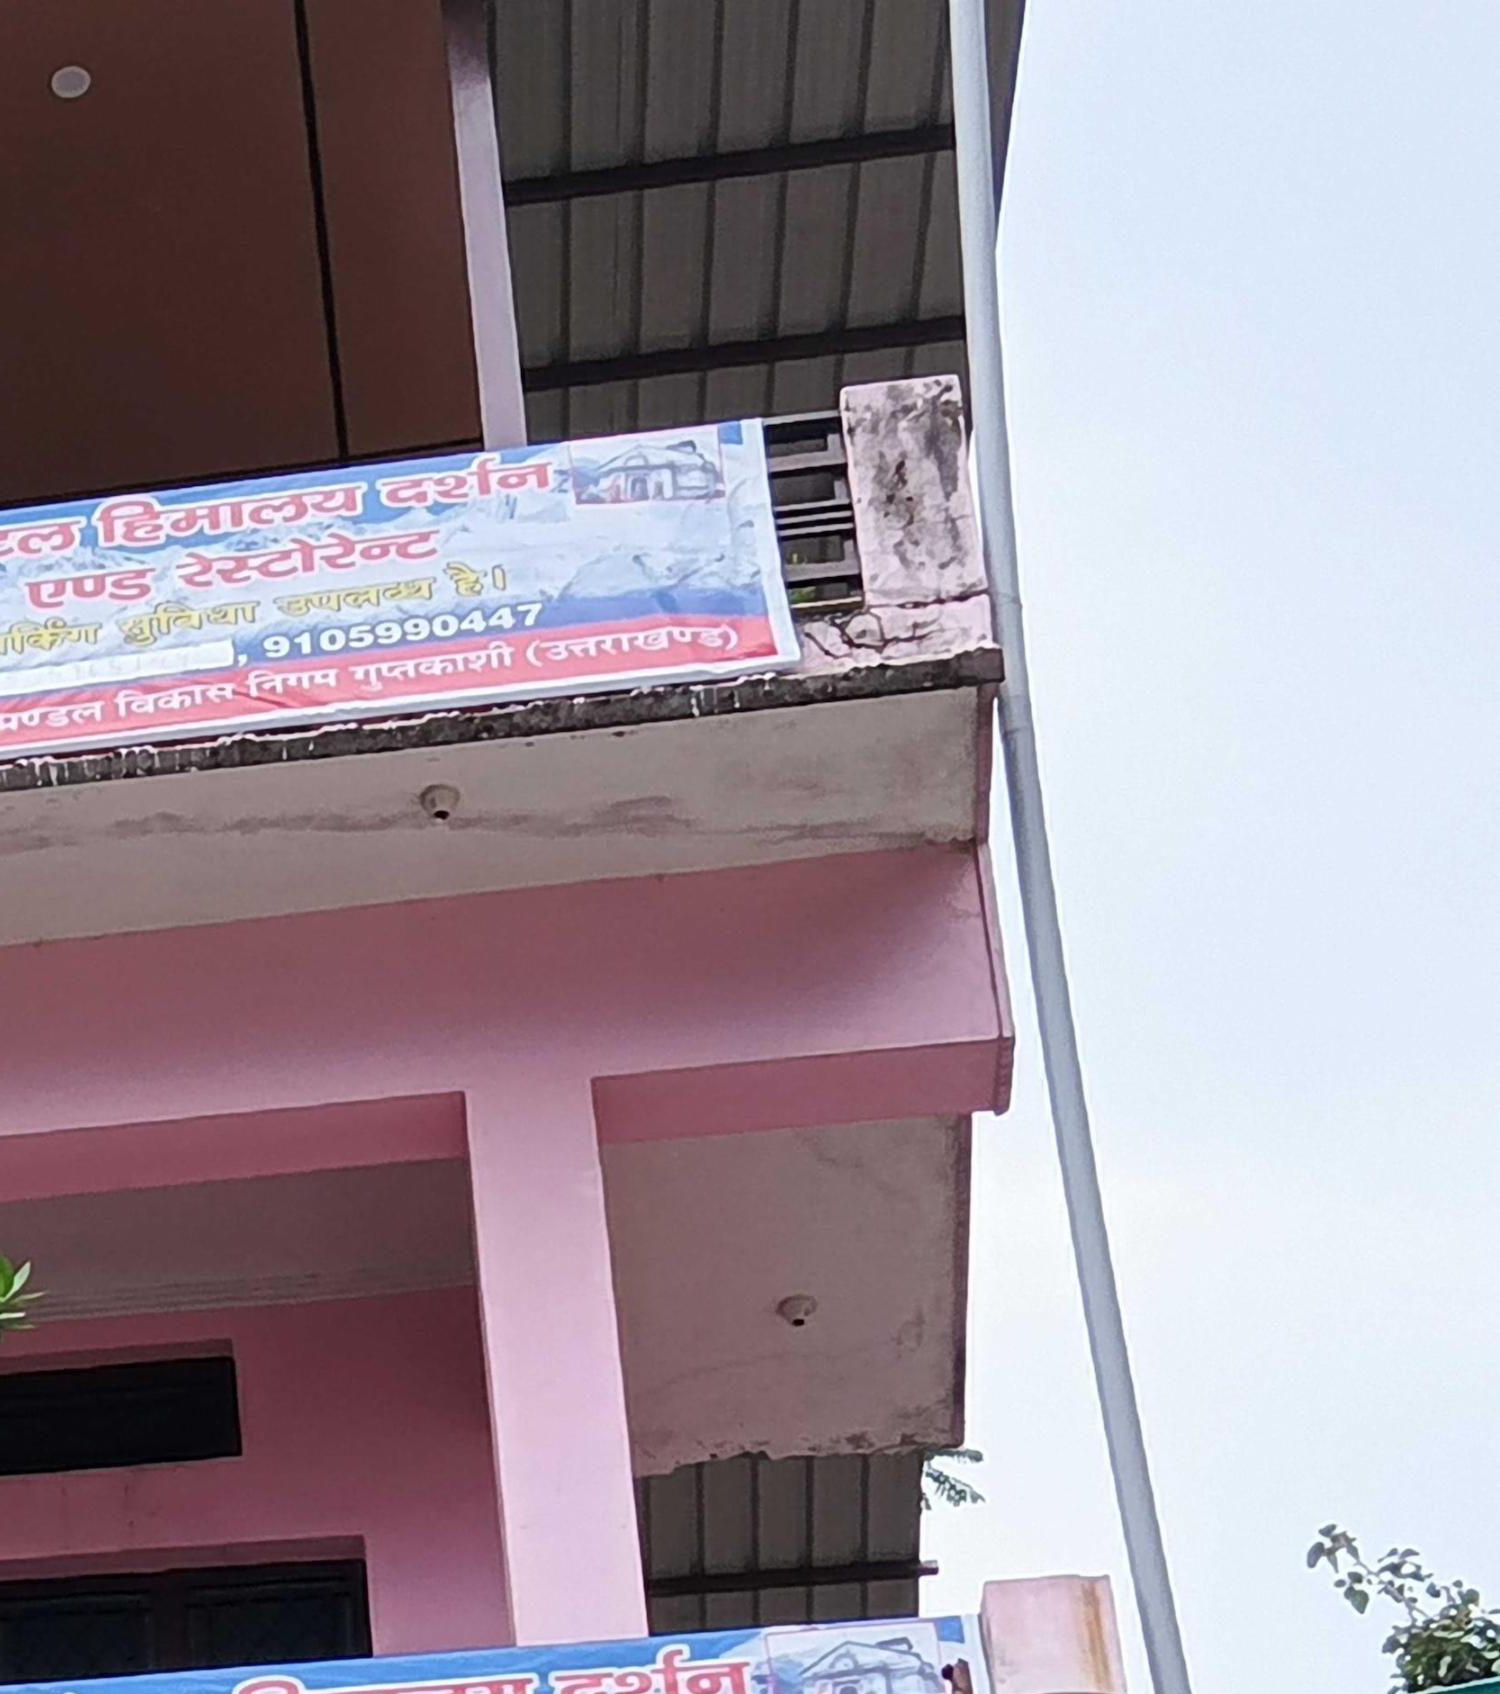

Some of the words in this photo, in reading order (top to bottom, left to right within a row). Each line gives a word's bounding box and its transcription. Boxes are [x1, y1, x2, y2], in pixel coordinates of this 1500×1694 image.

[97, 500, 362, 545] हिमालय
[382, 458, 552, 507] दर्शन
[26, 567, 156, 609] एण्ड
[176, 529, 440, 587] रेस्टोरेन्ट
[115, 681, 237, 718] विकास
[249, 666, 340, 696] निगम
[348, 640, 515, 692] गुप्तकाशी
[525, 623, 740, 668] (उत्तराखण्ड)
[262, 603, 544, 658] 9105990447
